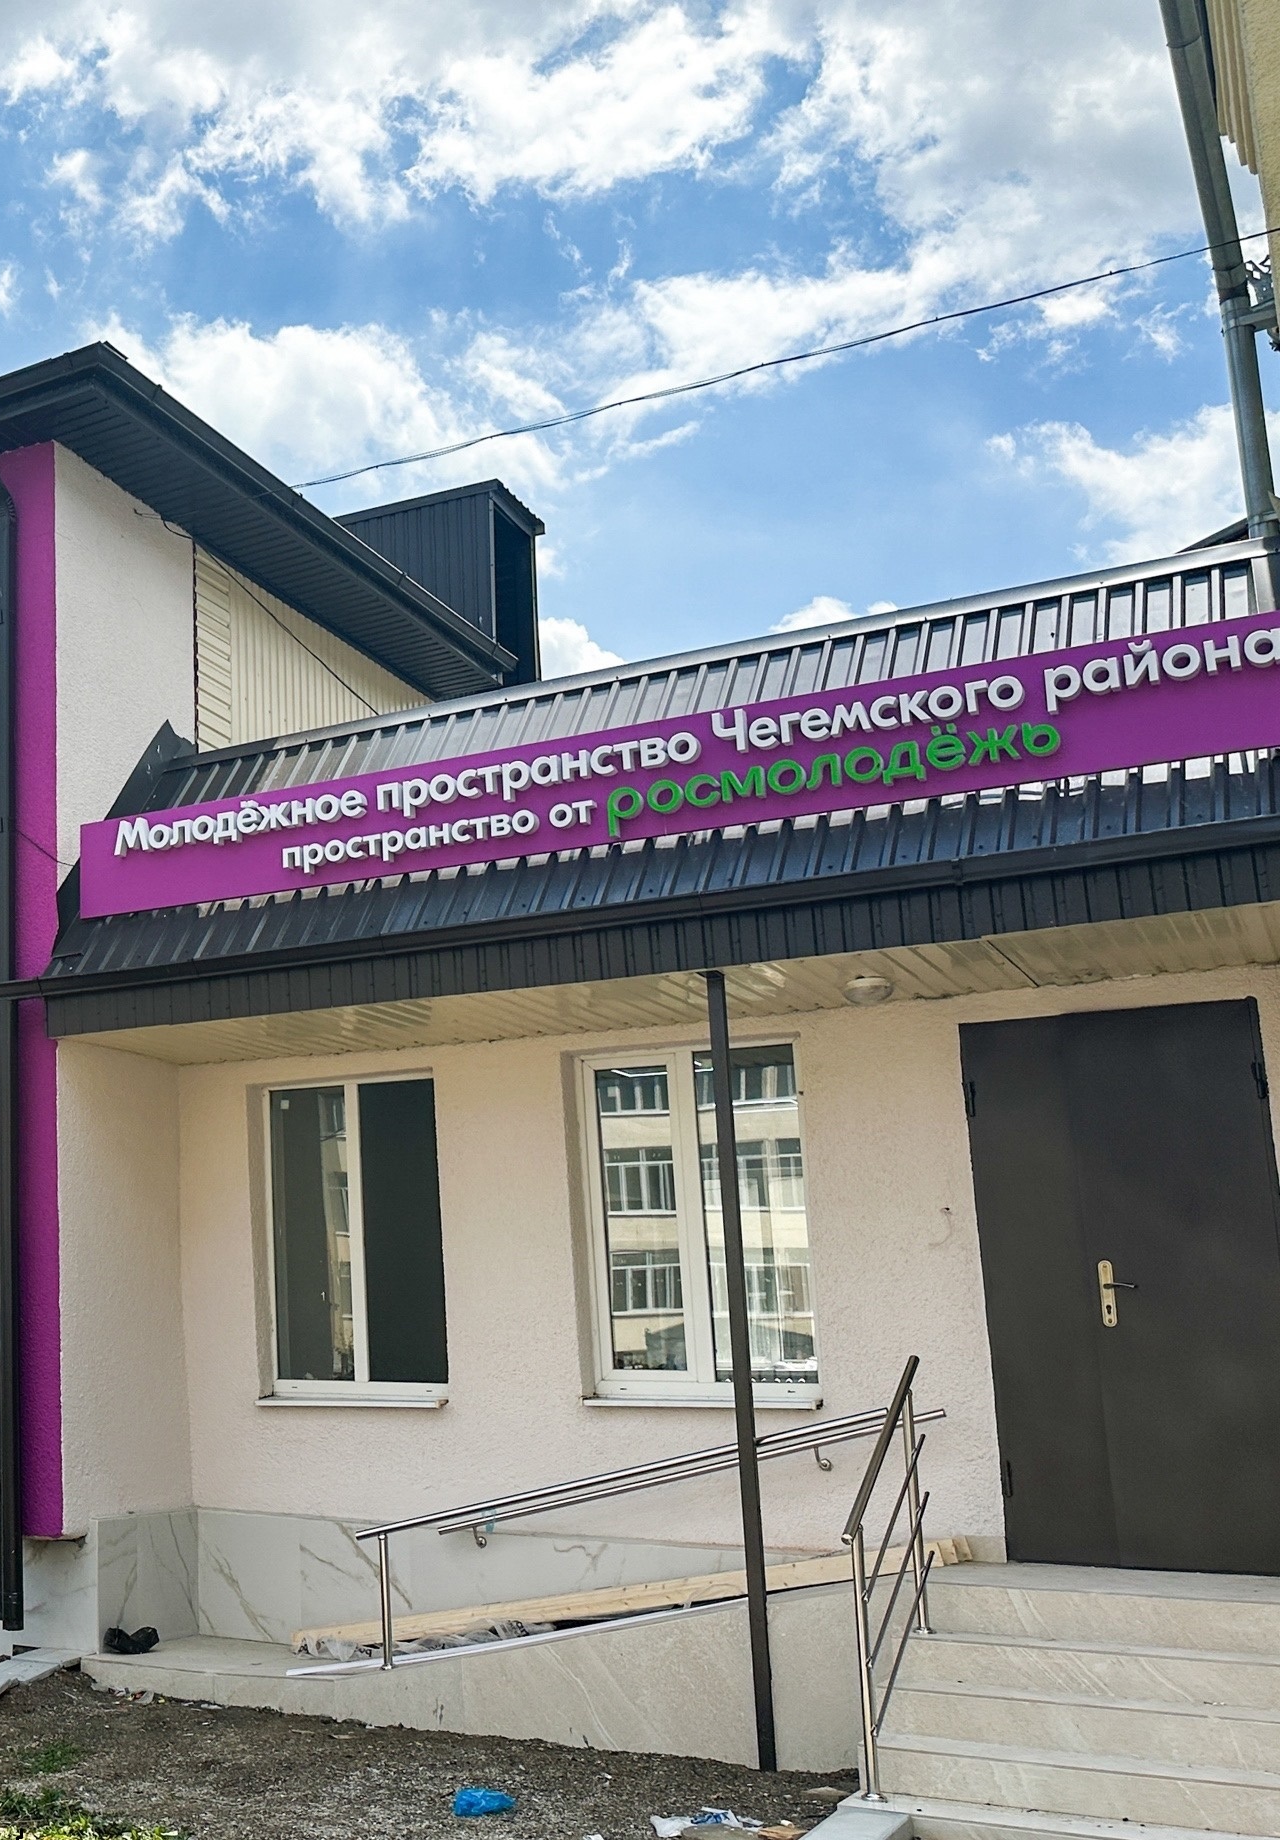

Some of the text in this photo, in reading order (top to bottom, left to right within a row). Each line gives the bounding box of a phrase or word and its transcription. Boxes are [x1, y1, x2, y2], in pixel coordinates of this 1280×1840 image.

[114, 628, 1280, 857] Молодёжное пространство Чегемского района
[281, 721, 1062, 875] пространство от росмолодёжь
